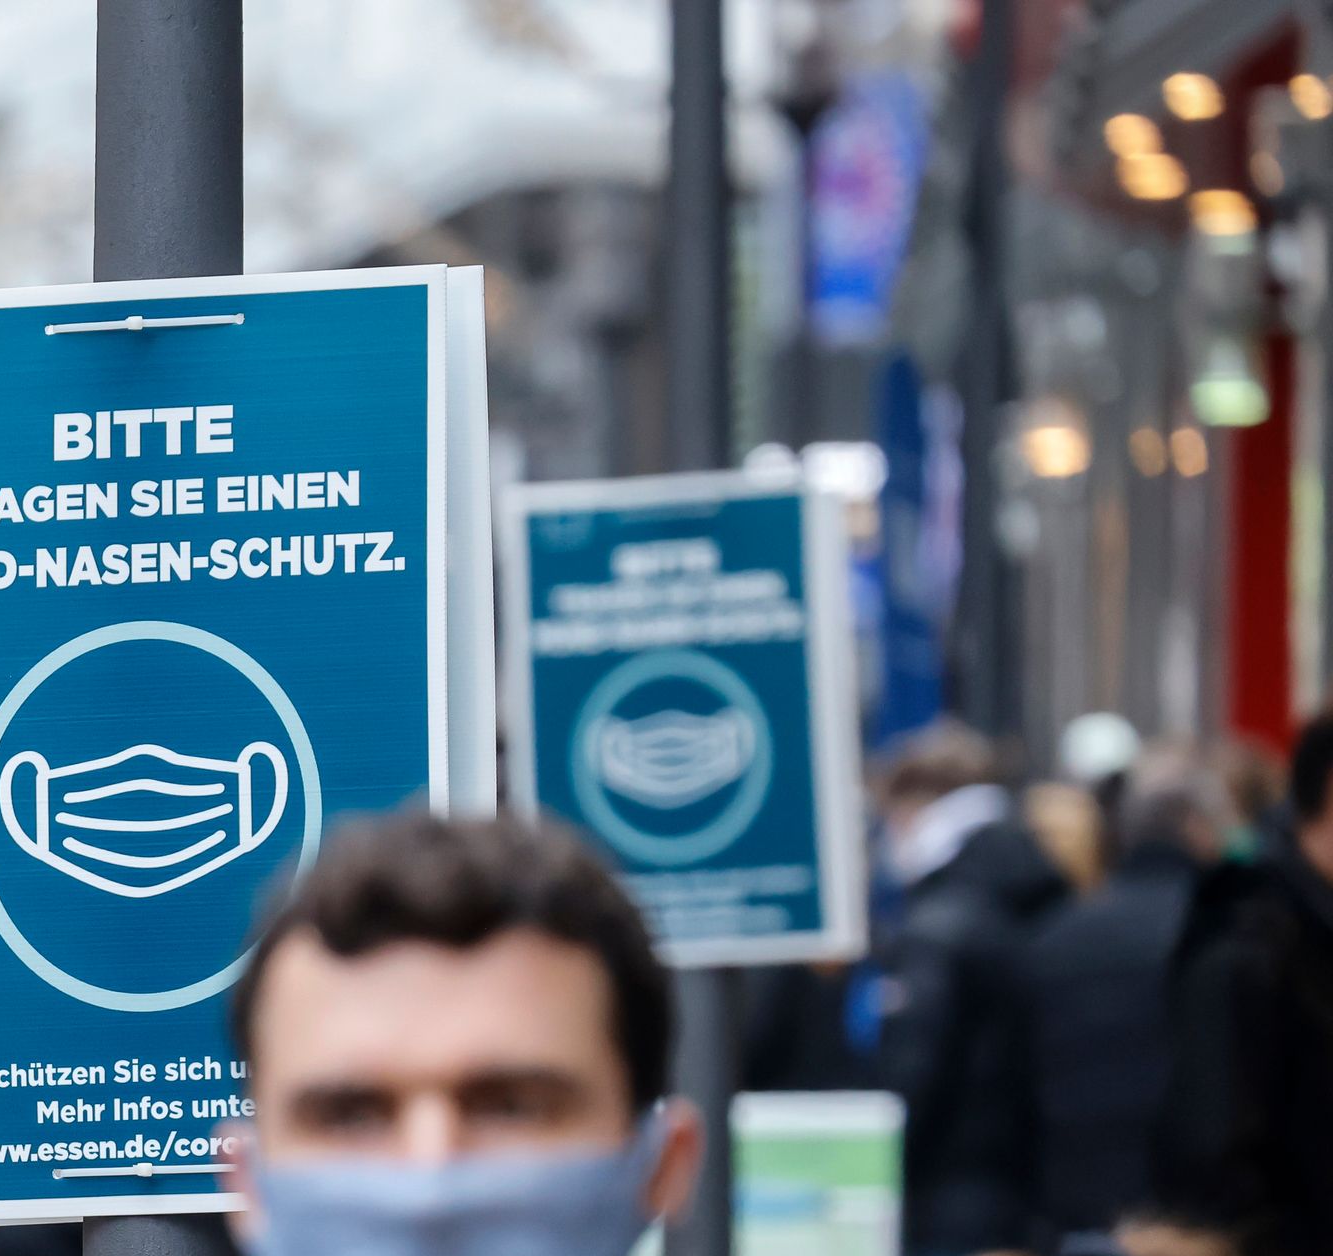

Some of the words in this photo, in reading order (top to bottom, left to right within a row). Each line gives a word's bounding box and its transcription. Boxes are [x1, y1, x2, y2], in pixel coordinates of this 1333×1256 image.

[53, 404, 234, 461] BITTE
[129, 478, 204, 517] SIE
[217, 470, 360, 513] EINEN
[113, 1058, 157, 1083] Sie
[164, 1056, 222, 1082] sich
[36, 1098, 106, 1124] Mehr
[113, 1095, 184, 1121] Infos
[192, 1094, 257, 1118] unte
